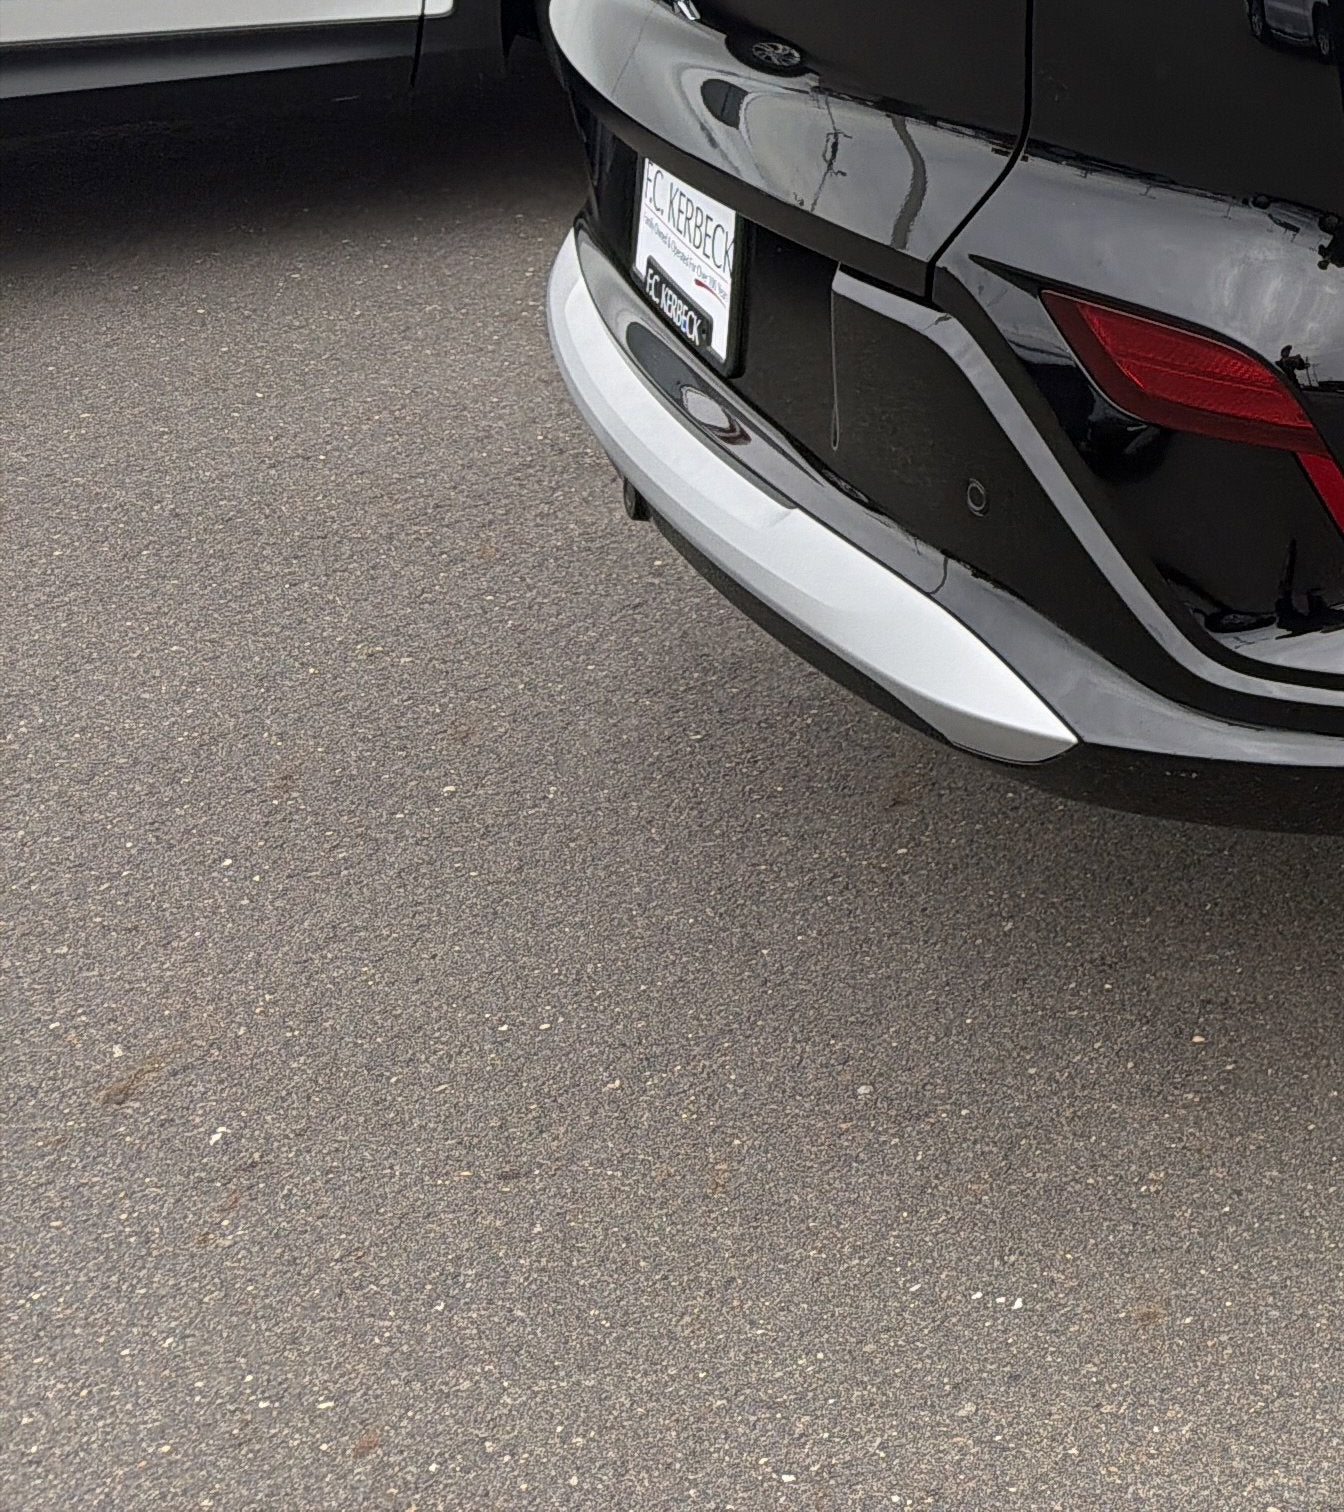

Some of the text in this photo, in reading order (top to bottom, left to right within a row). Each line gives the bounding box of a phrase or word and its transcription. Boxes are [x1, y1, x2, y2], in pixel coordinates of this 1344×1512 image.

[644, 161, 735, 273] F.C. KERBECK
[660, 283, 702, 347] KERBECK
